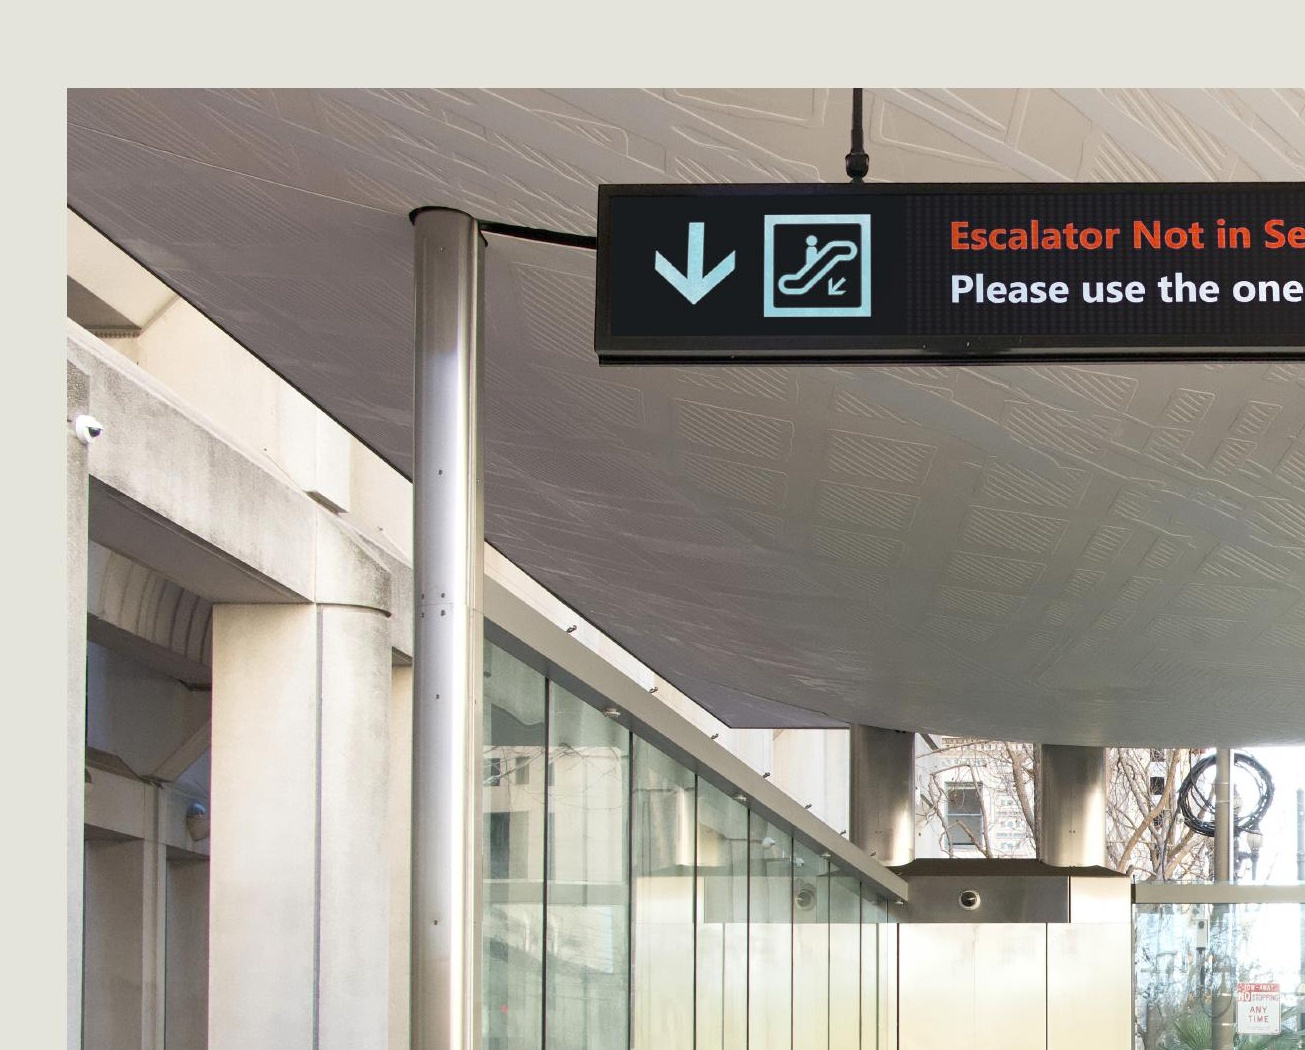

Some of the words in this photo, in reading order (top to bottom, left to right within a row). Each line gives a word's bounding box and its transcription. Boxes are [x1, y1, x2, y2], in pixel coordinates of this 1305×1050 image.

[950, 218, 1122, 251] Escalator
[1132, 219, 1206, 250] Not
[1215, 217, 1252, 249] in
[950, 272, 1070, 304] Please
[1082, 280, 1147, 304] use
[1156, 272, 1221, 304] the
[1231, 280, 1305, 303] one
[1238, 991, 1250, 1000] NO
[1249, 1005, 1267, 1014] ANY
[1249, 1015, 1269, 1023] TIME
